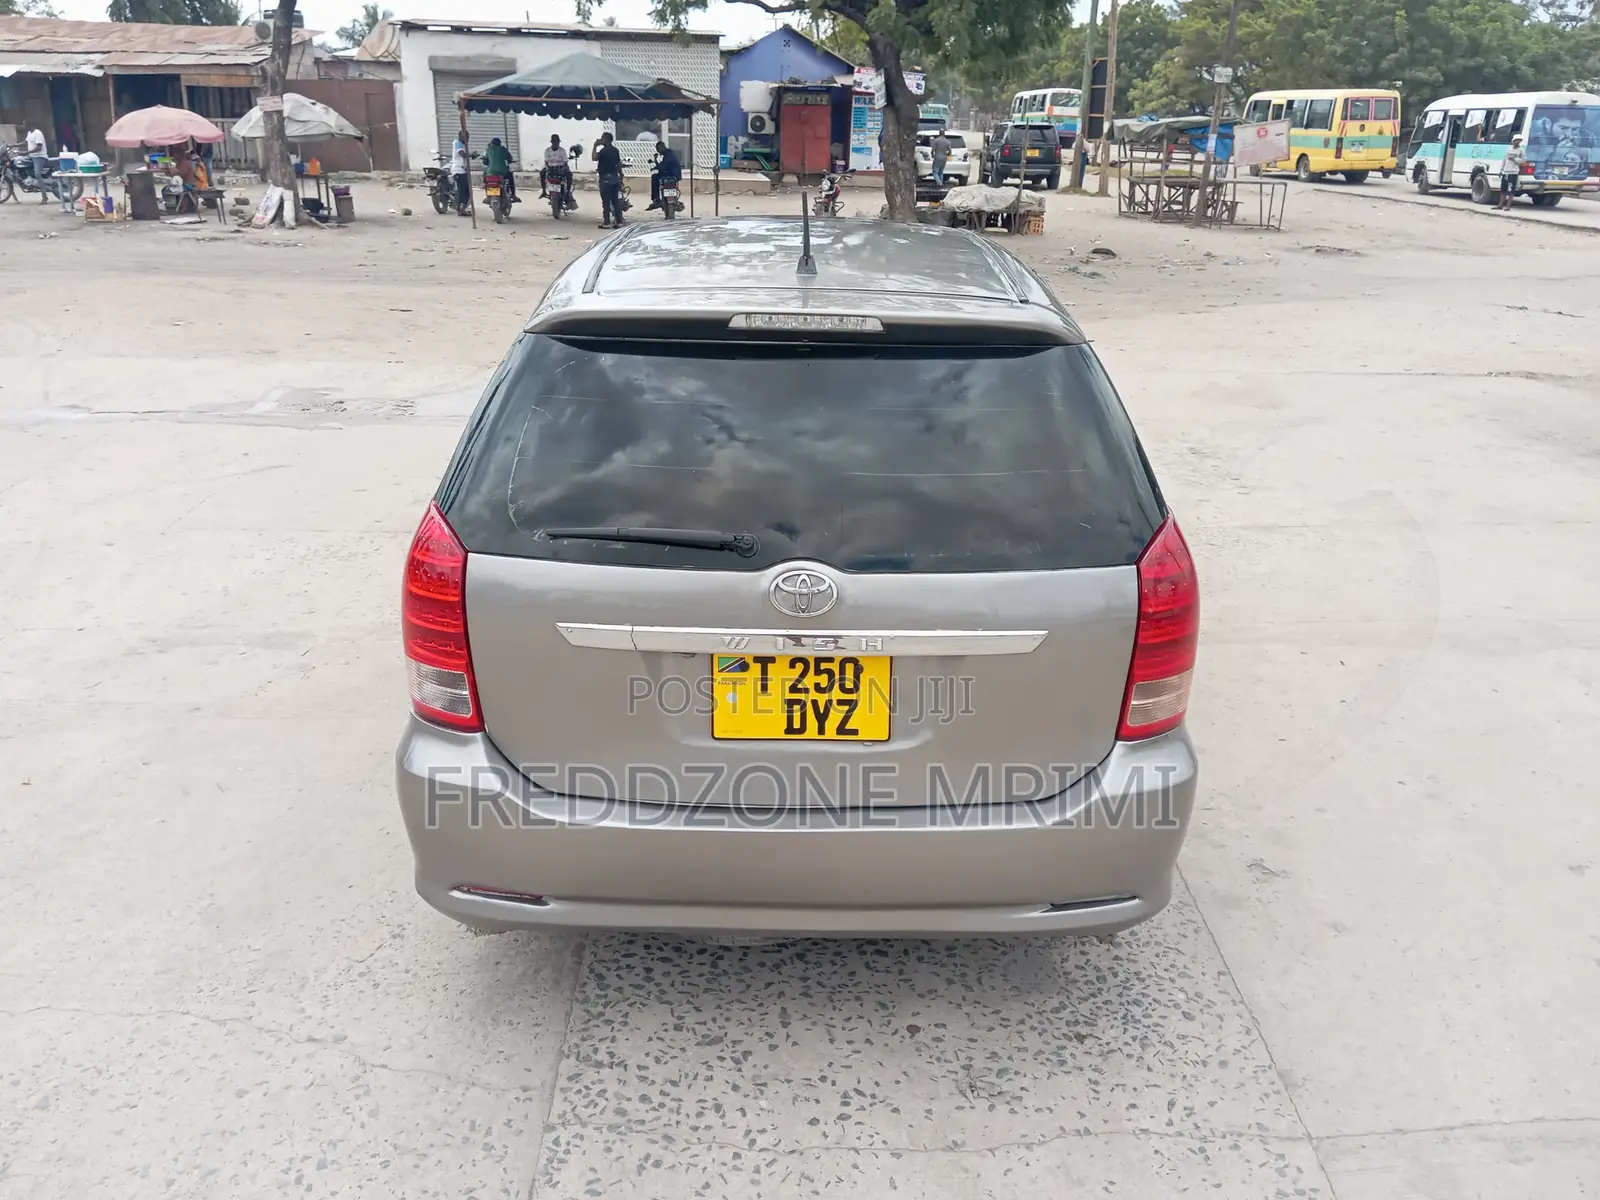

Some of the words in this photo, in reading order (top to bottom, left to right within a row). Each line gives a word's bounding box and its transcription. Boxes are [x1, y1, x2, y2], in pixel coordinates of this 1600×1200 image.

[721, 636, 884, 651] WISH
[752, 656, 777, 694] T
[788, 656, 863, 695] 250
[783, 698, 860, 736] DYZ
